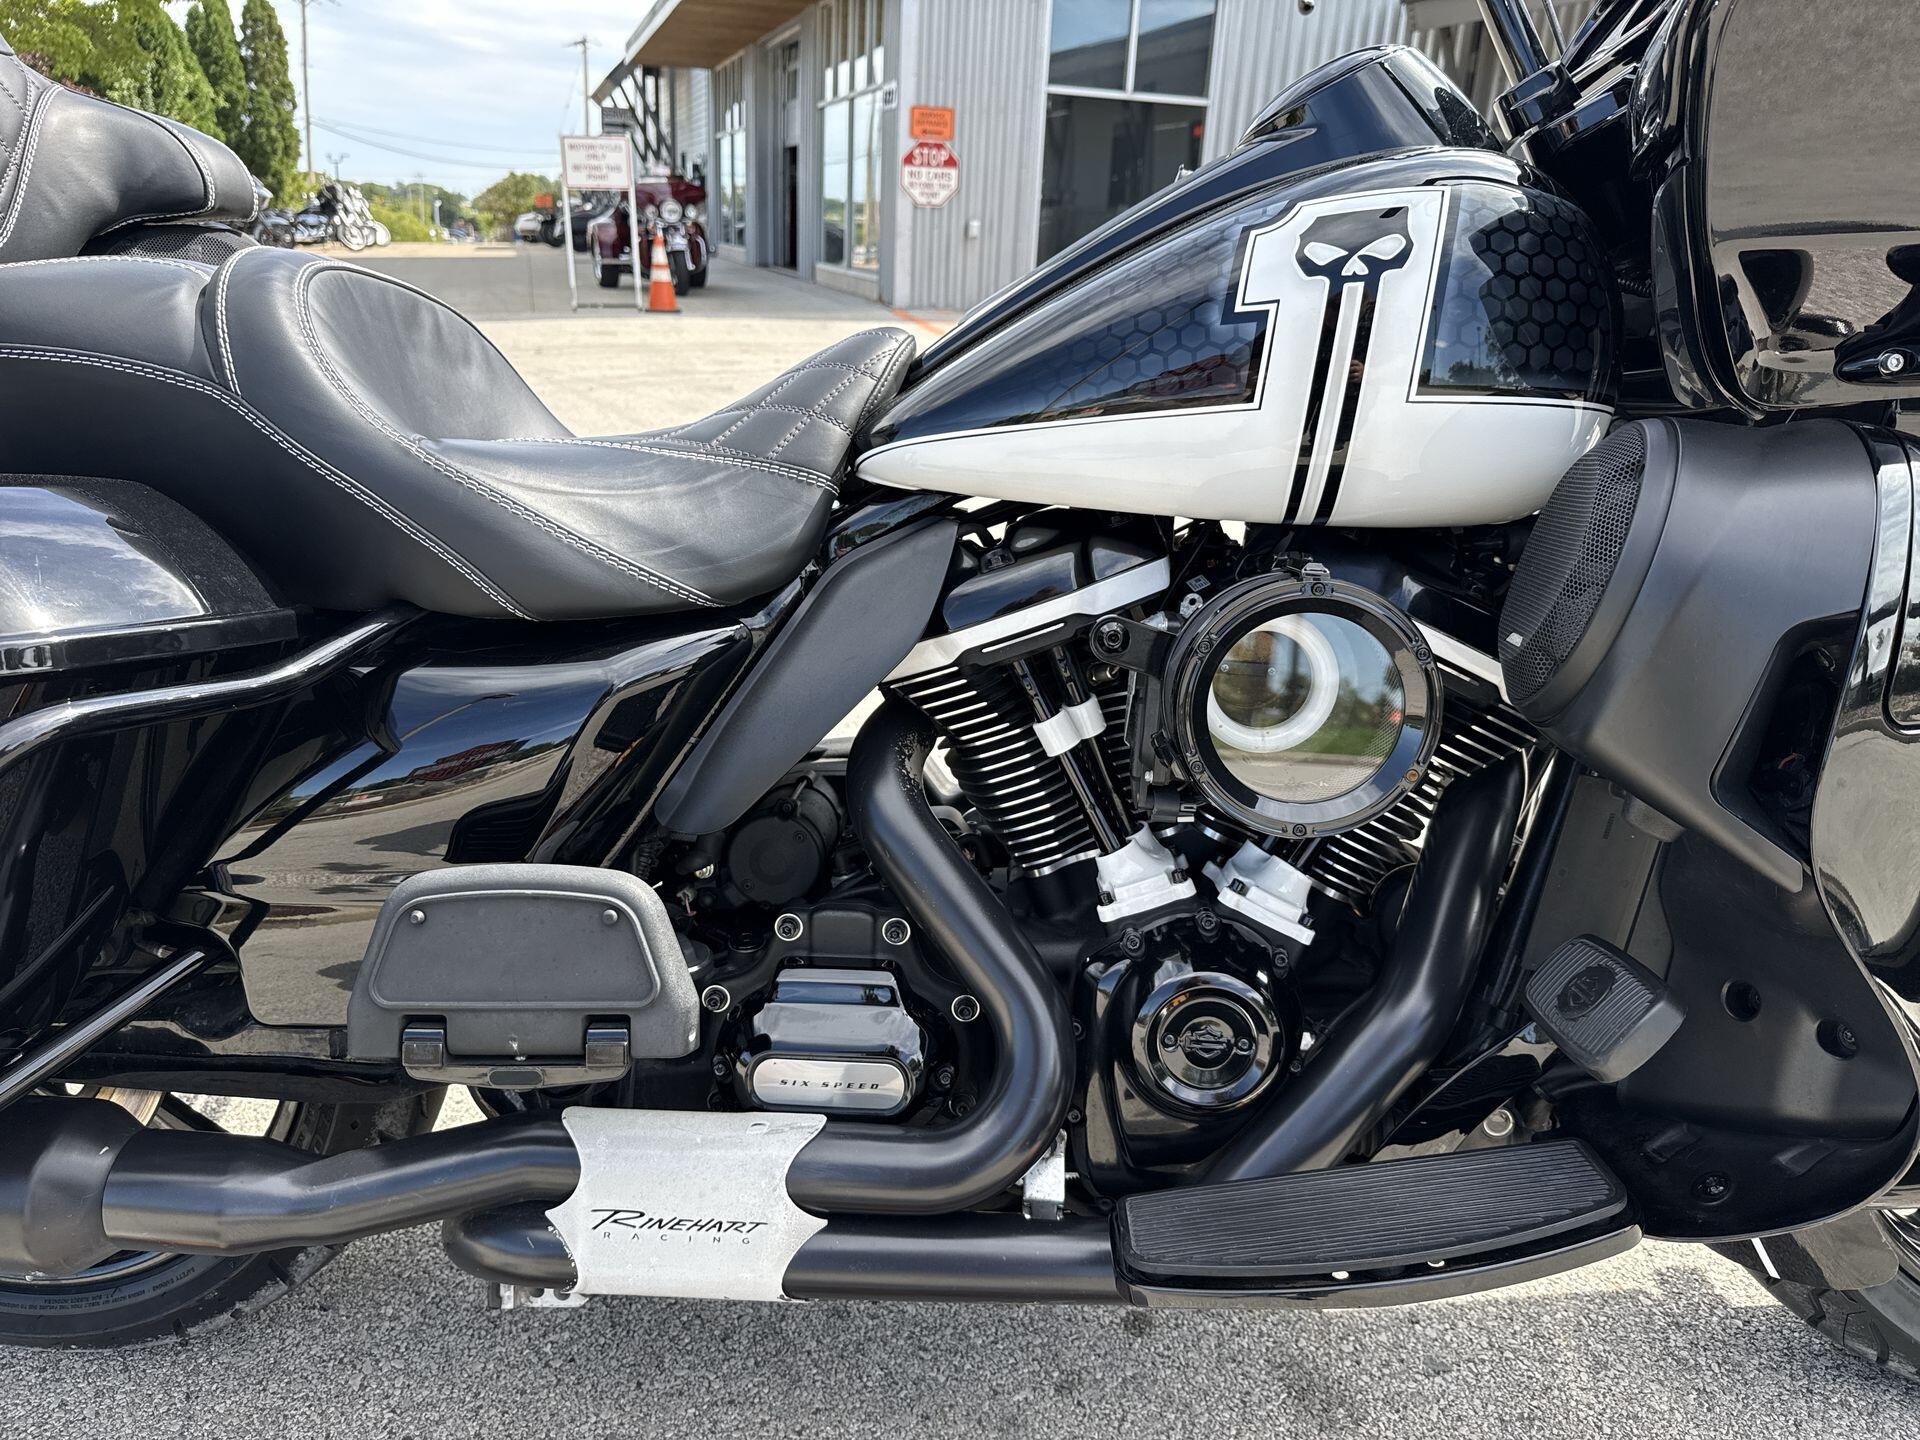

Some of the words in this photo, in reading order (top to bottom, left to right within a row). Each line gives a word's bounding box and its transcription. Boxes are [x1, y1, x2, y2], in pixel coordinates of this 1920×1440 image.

[912, 147, 950, 167] STOP
[908, 169, 923, 179] NO
[926, 170, 953, 181] CARS
[779, 1079, 810, 1088] SIX
[821, 1081, 881, 1090] SPEED
[590, 1208, 768, 1235] RINEHART
[603, 1231, 751, 1245] RACING
